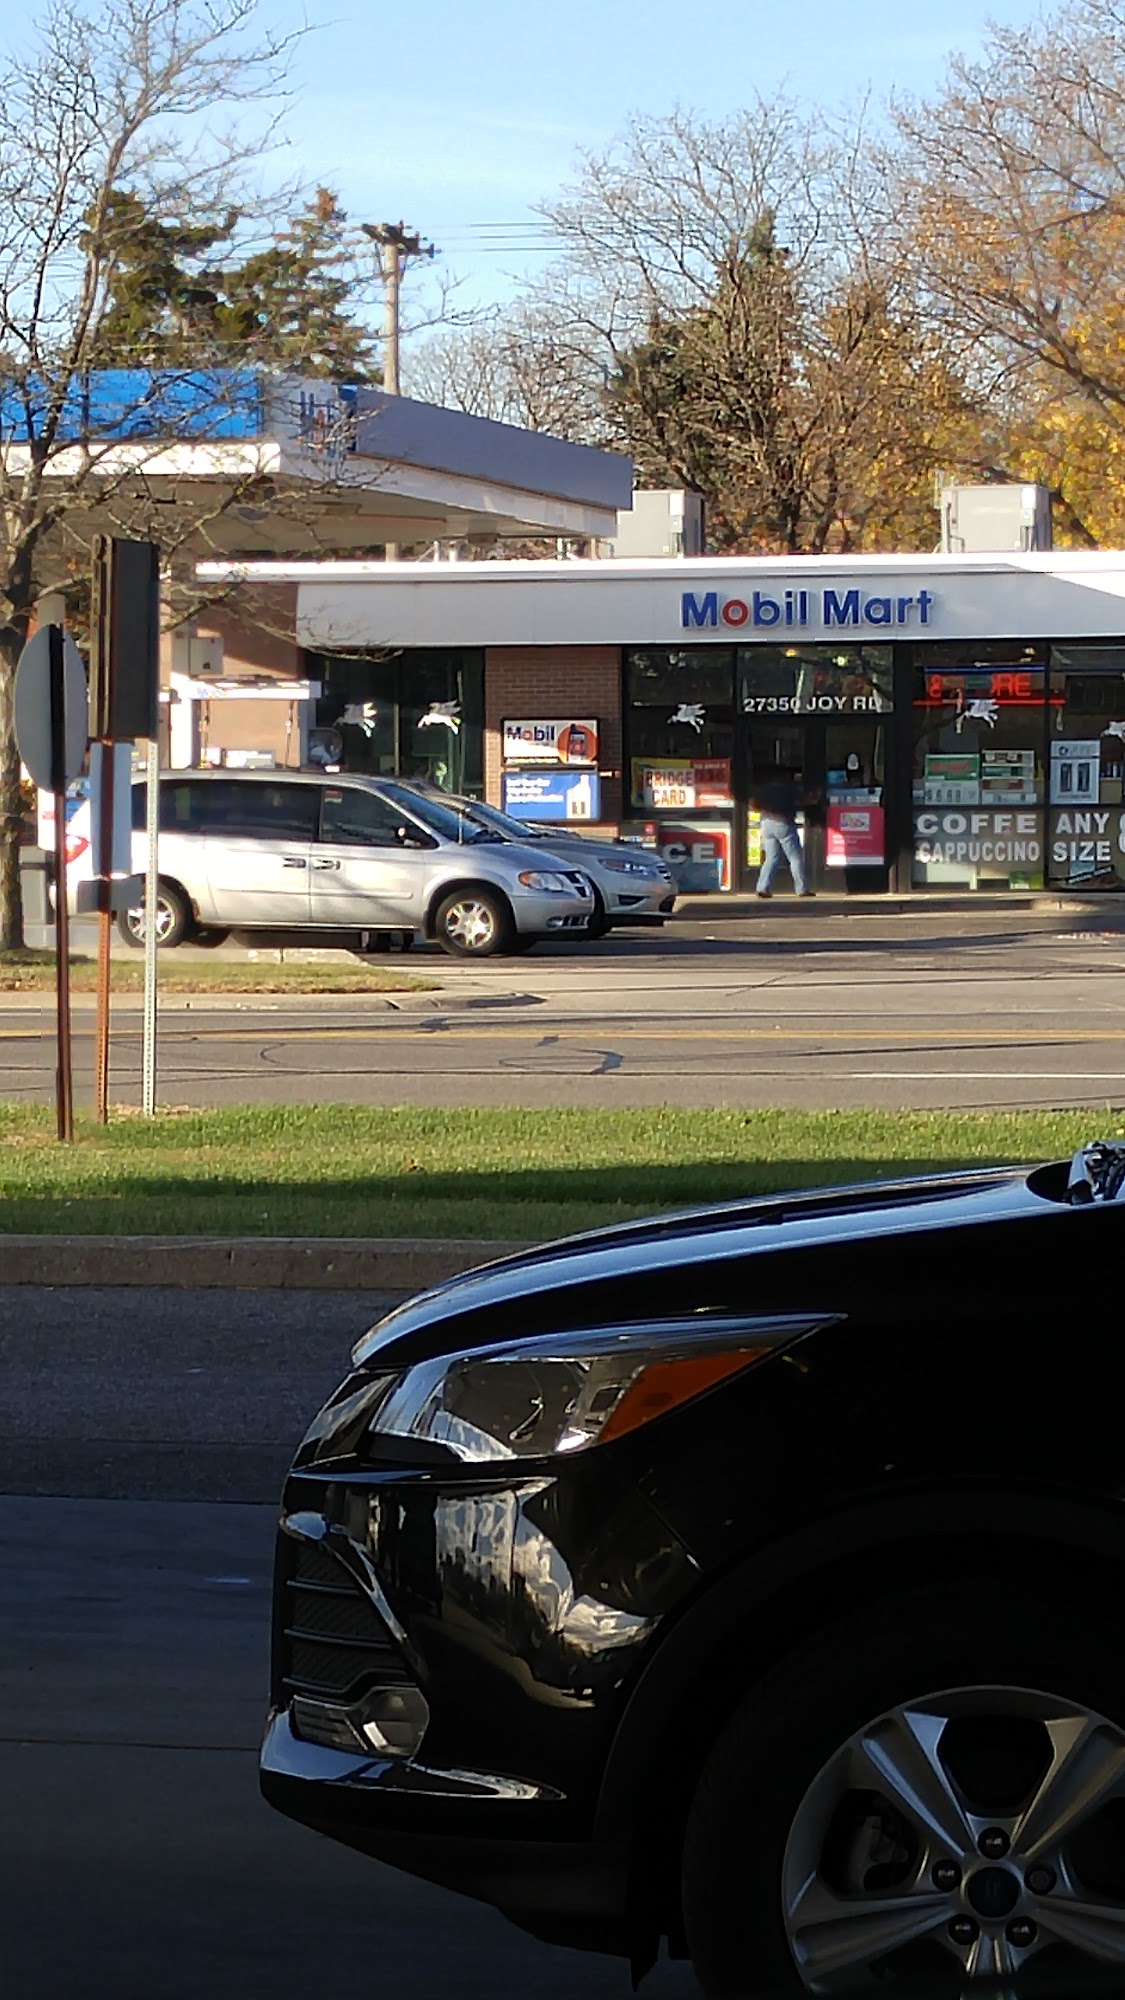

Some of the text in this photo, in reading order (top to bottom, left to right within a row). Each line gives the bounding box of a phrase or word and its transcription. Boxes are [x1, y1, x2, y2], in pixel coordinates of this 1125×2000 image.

[682, 589, 932, 628] Mobil Mart
[744, 696, 882, 713] 27350 JOY RD
[507, 725, 555, 741] Mobil
[646, 771, 693, 786] BRIDGE
[652, 789, 686, 805] CARD
[916, 814, 1037, 834] COFFE
[1055, 813, 1110, 834] ANY
[919, 842, 1040, 863] CAPPUCCINO
[1053, 841, 1111, 862] SIZE
